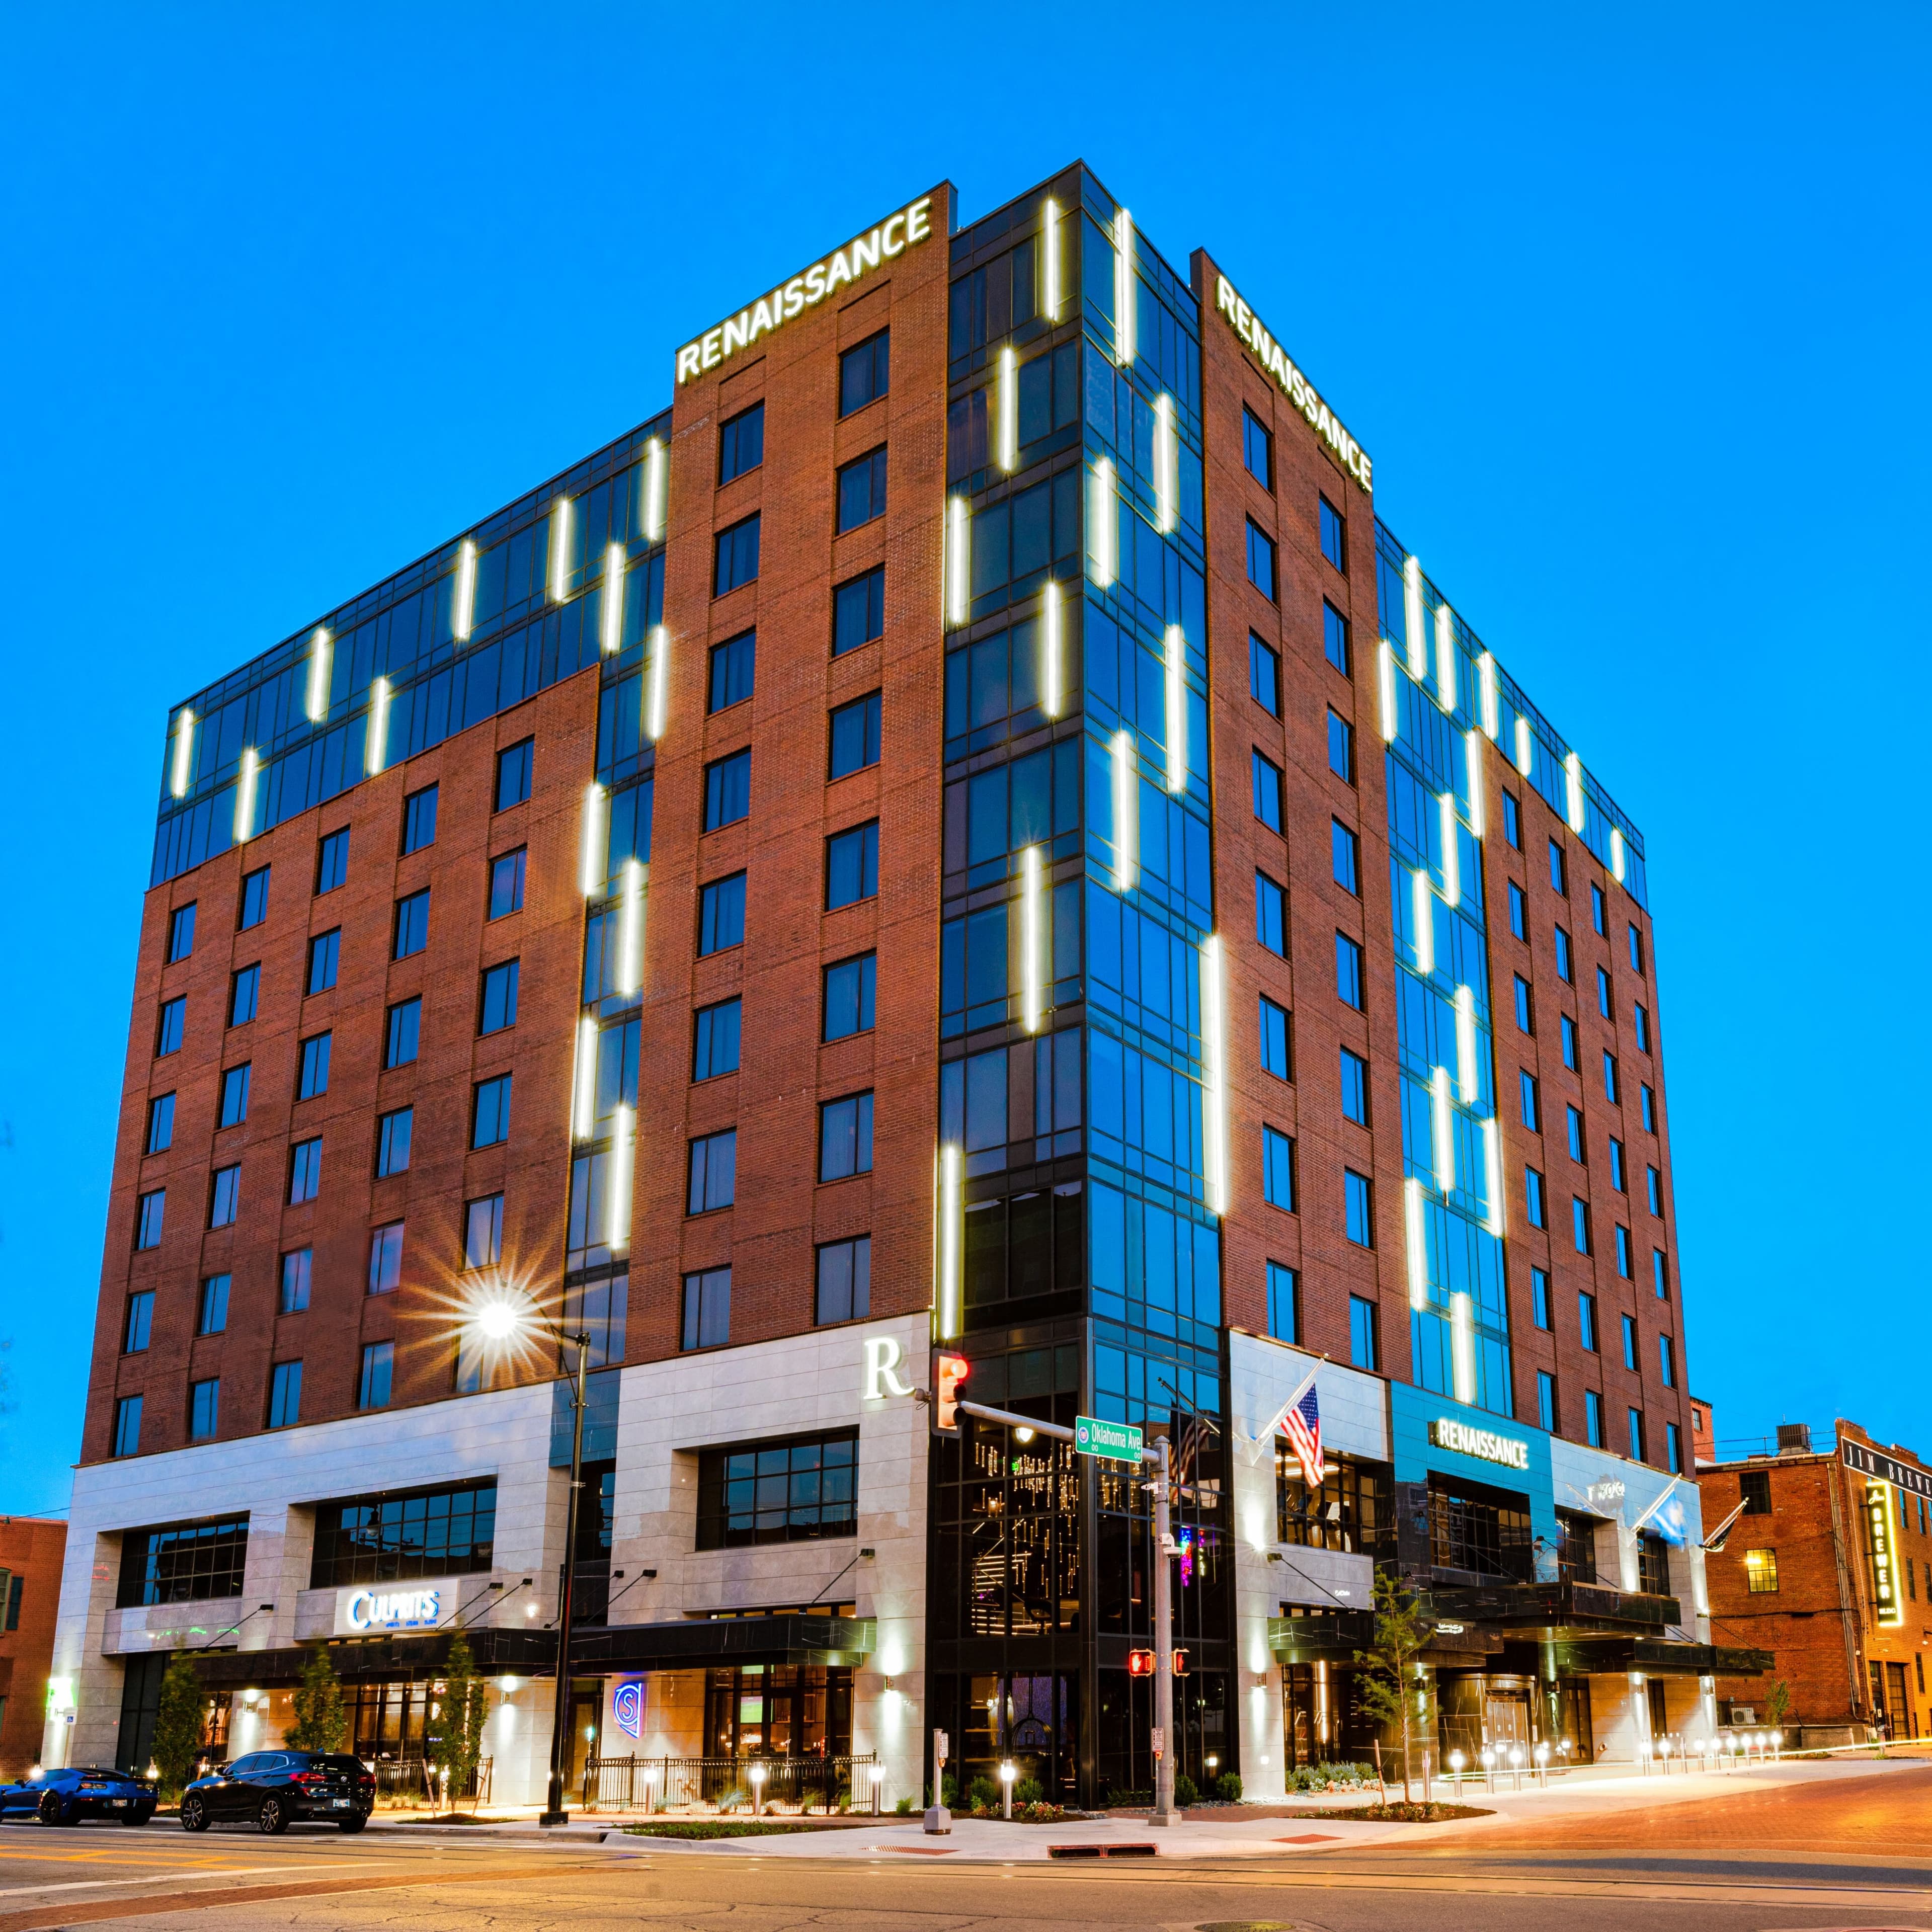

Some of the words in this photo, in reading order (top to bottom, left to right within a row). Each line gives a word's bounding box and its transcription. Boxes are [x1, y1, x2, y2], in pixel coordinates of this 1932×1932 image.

[678, 198, 931, 383] RENAISSANCE
[1217, 275, 1372, 492] RENAISSANCE
[863, 1337, 915, 1400] R
[1091, 1423, 1126, 1448] Oklahoma
[1128, 1430, 1141, 1451] Ave
[1438, 1417, 1529, 1469] RENAISSANCE
[1848, 1445, 1875, 1472] JIM
[1888, 1463, 1931, 1495] BREWE
[1868, 1489, 1885, 1504] Jim
[1872, 1508, 1890, 1599] BREWER
